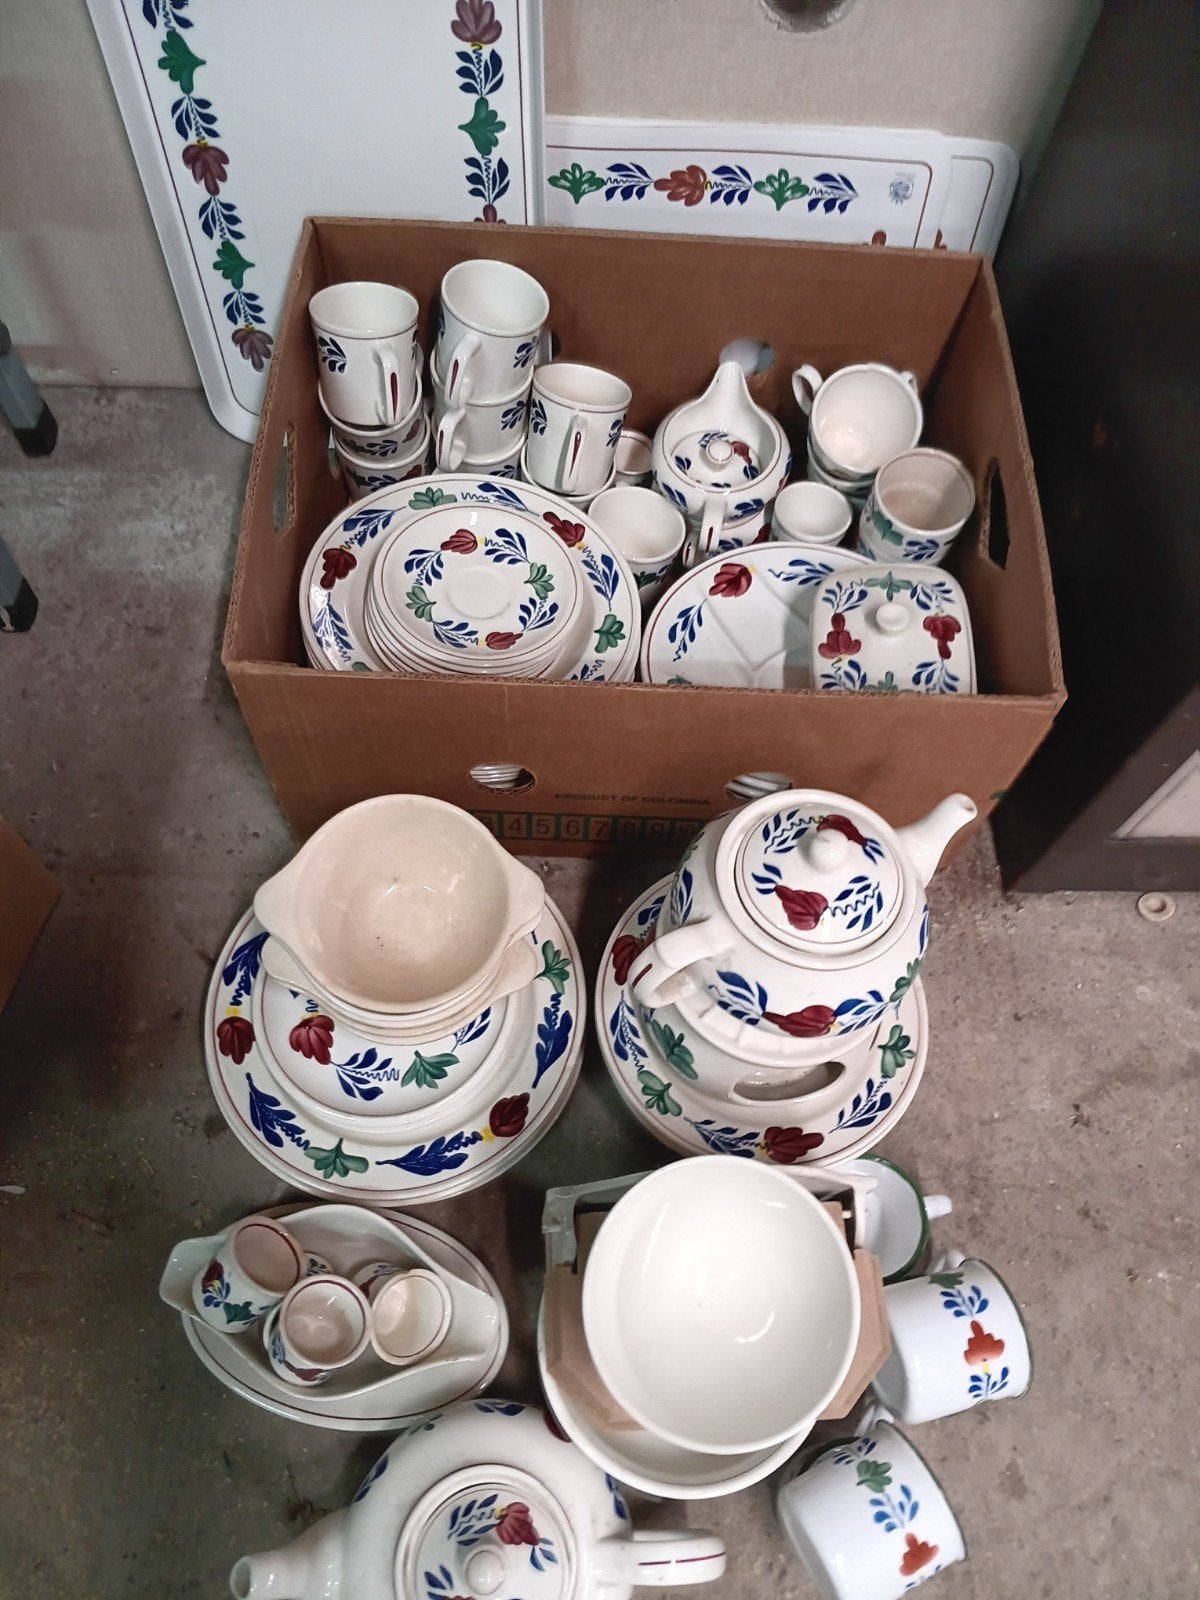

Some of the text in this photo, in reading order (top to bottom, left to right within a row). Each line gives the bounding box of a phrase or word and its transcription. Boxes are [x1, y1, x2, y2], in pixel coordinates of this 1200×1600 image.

[555, 792, 711, 805] PRODUCT OF COLOMBIA
[508, 817, 522, 833] 4
[536, 819, 550, 835] 5
[566, 820, 580, 836] 6
[594, 821, 609, 837] 7
[623, 822, 637, 838] 8
[650, 823, 665, 838] 9
[676, 823, 696, 840] 10
